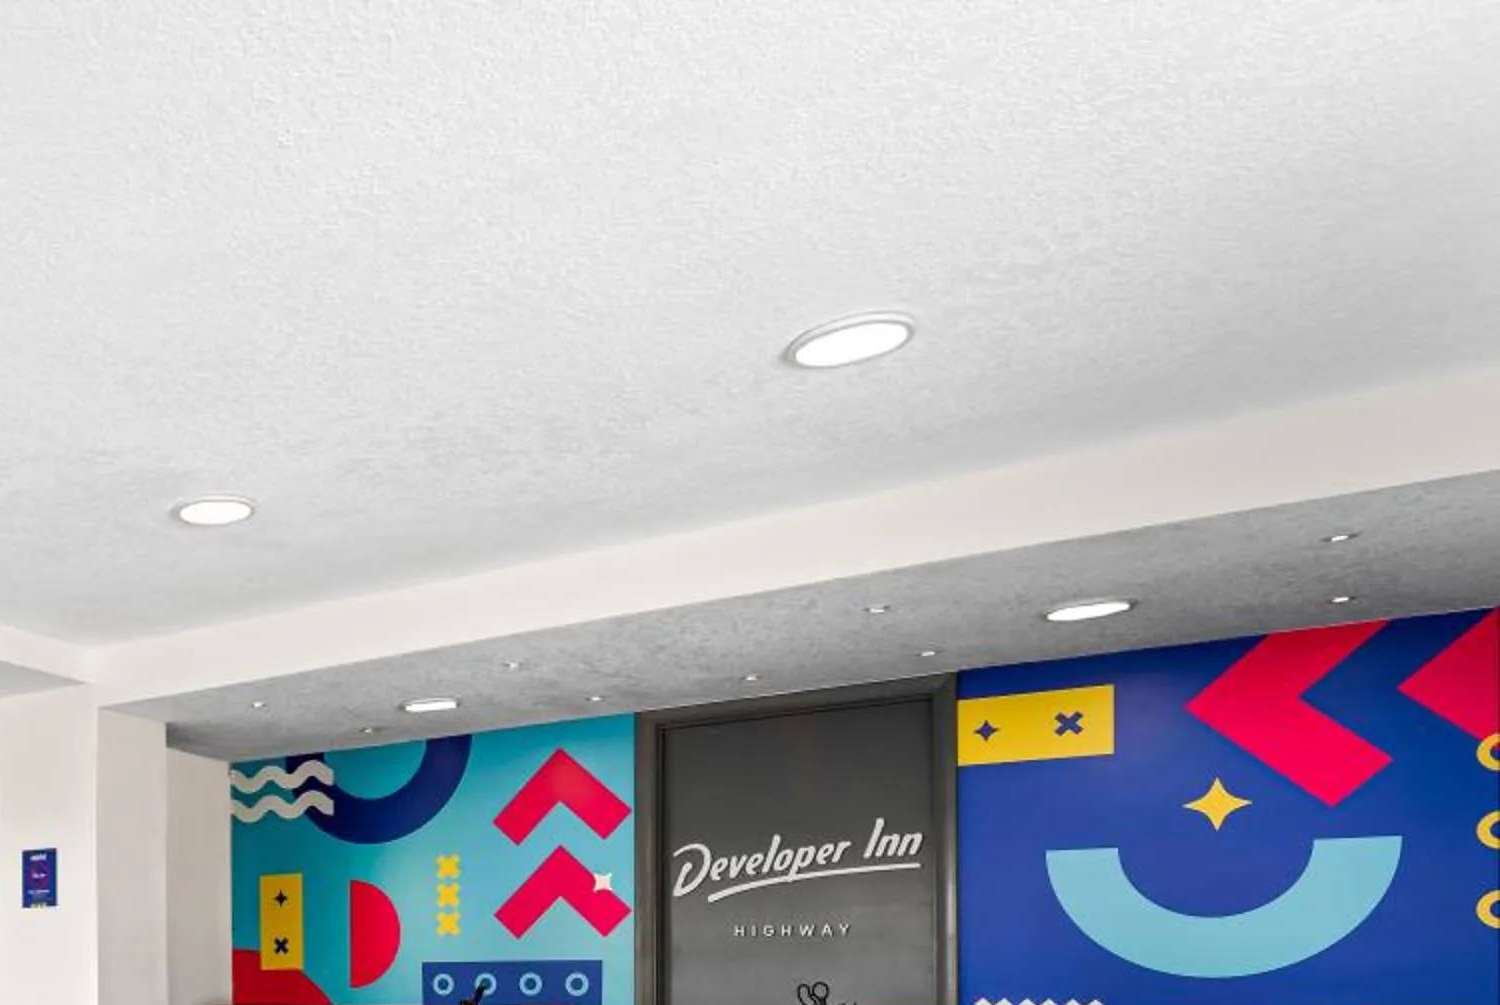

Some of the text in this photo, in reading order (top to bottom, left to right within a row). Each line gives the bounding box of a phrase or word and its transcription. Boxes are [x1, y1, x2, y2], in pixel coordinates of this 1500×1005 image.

[672, 816, 924, 898] Developer Inn
[733, 923, 852, 937] HIGHWAY
